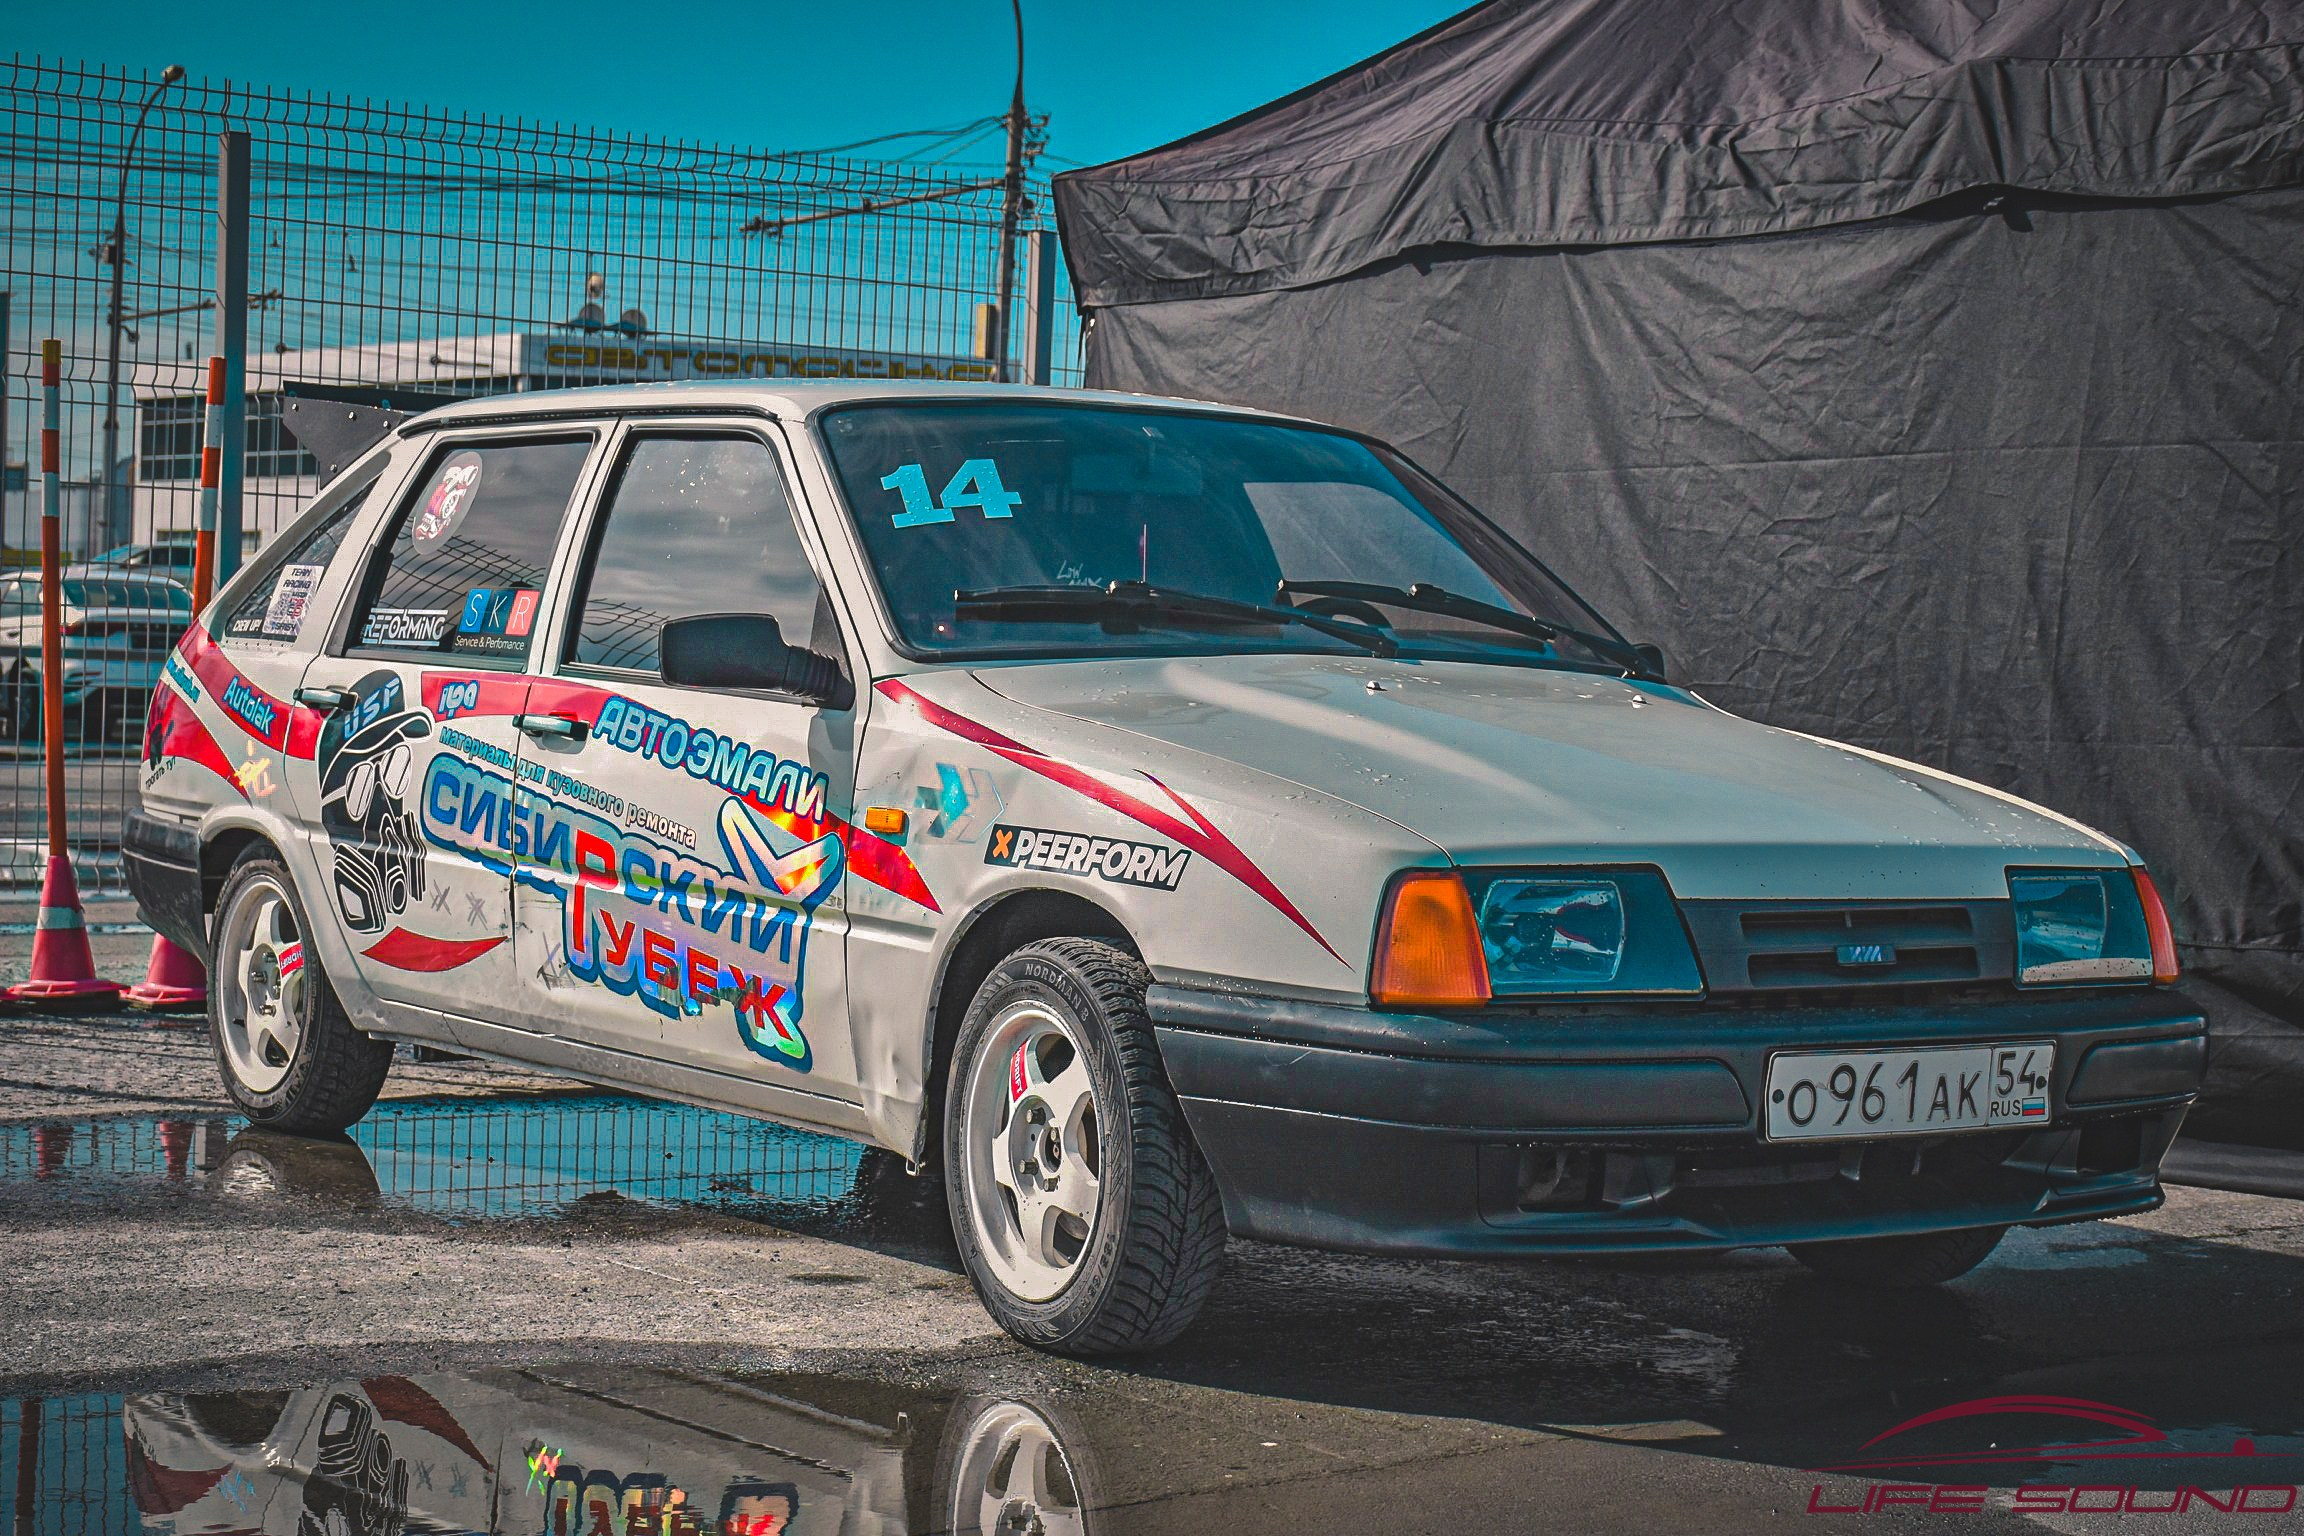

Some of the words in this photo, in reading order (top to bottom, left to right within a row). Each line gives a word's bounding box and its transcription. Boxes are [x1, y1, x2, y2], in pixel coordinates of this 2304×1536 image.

[881, 459, 1022, 528] 14
[291, 568, 312, 577] TEAM
[465, 593, 531, 630] SKR
[455, 635, 478, 647] Service
[479, 636, 485, 647] &
[222, 675, 277, 736] Autolak
[594, 697, 828, 822] АВТОЭМАЛИ
[439, 726, 517, 771] материалы
[517, 758, 546, 784] для
[546, 769, 624, 817] кузовного
[625, 802, 697, 850] ремонта
[1025, 963, 1082, 1010] NORDMAN
[1997, 1050, 2036, 1098] 54
[1989, 1100, 2021, 1117] RUS
